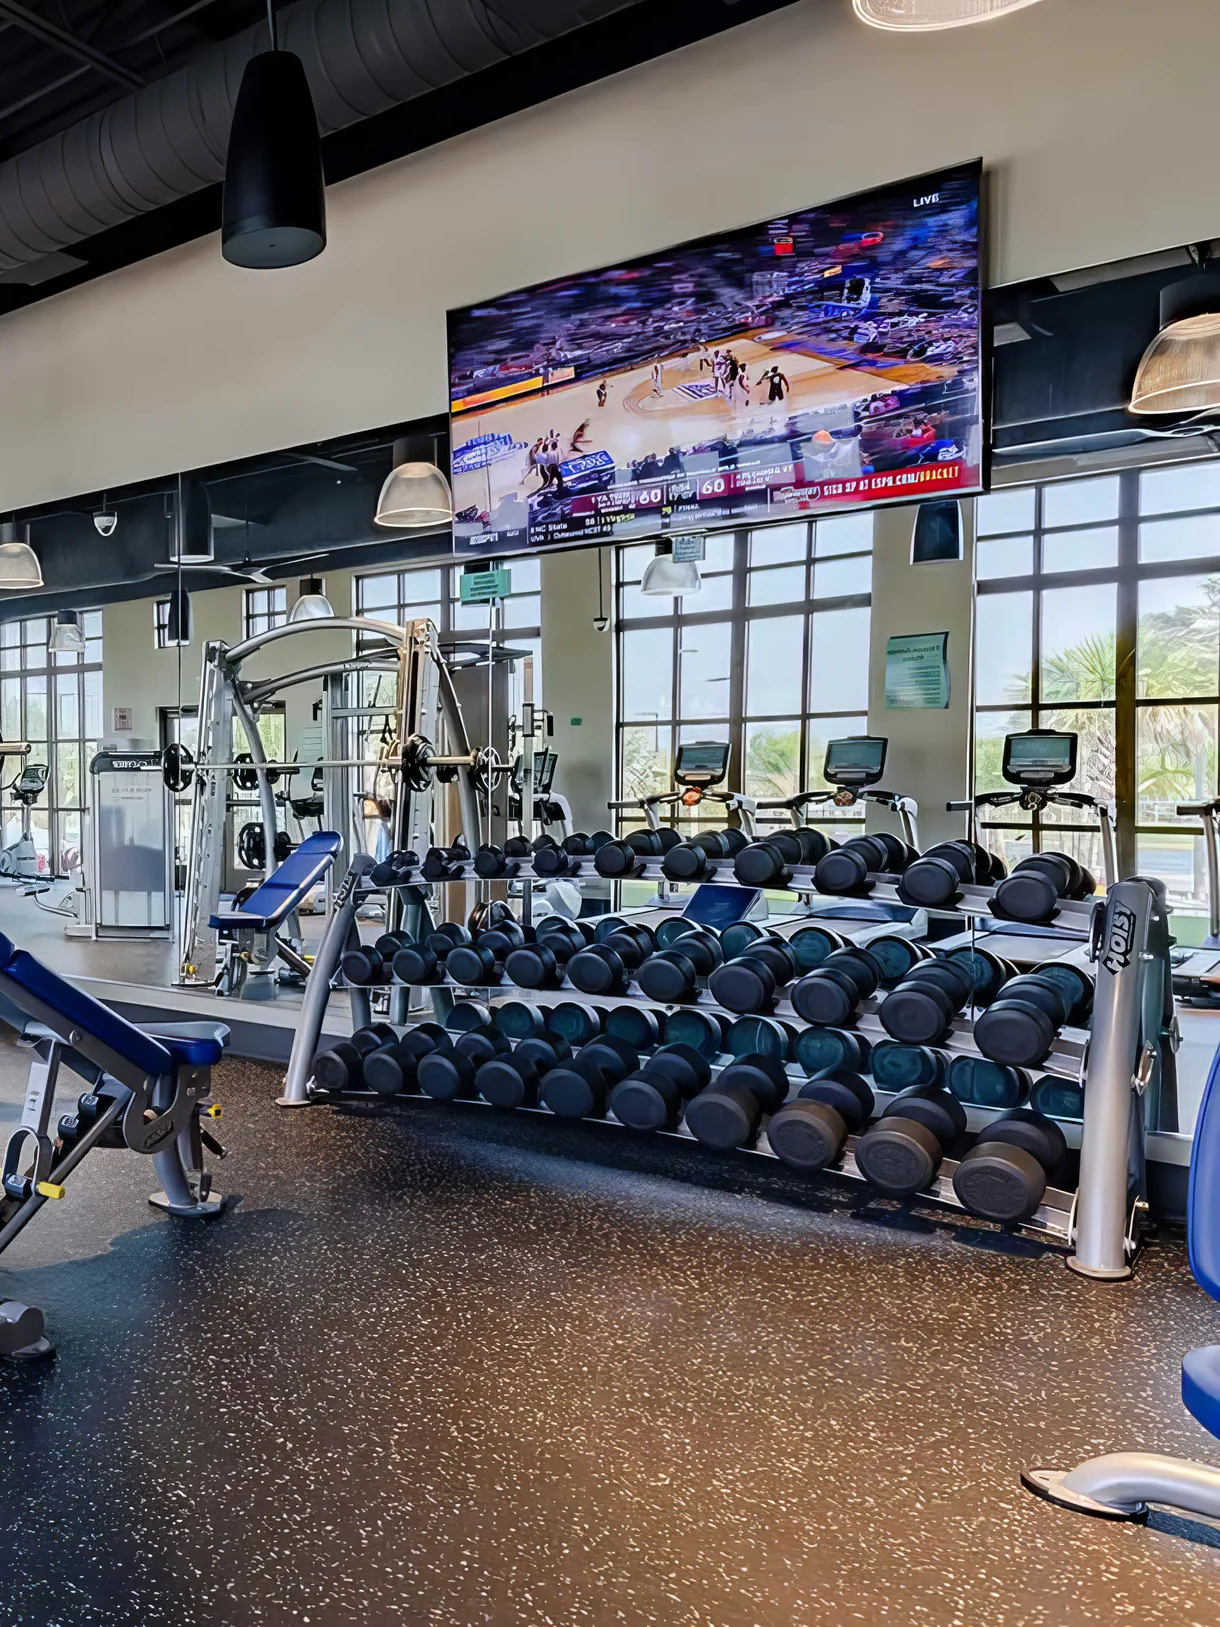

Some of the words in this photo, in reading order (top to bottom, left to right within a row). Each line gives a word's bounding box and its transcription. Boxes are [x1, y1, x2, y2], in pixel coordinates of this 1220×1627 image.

[913, 193, 940, 207] LIVE
[701, 478, 725, 494] 60
[638, 488, 662, 505] 60
[1105, 902, 1134, 973] HOIST
